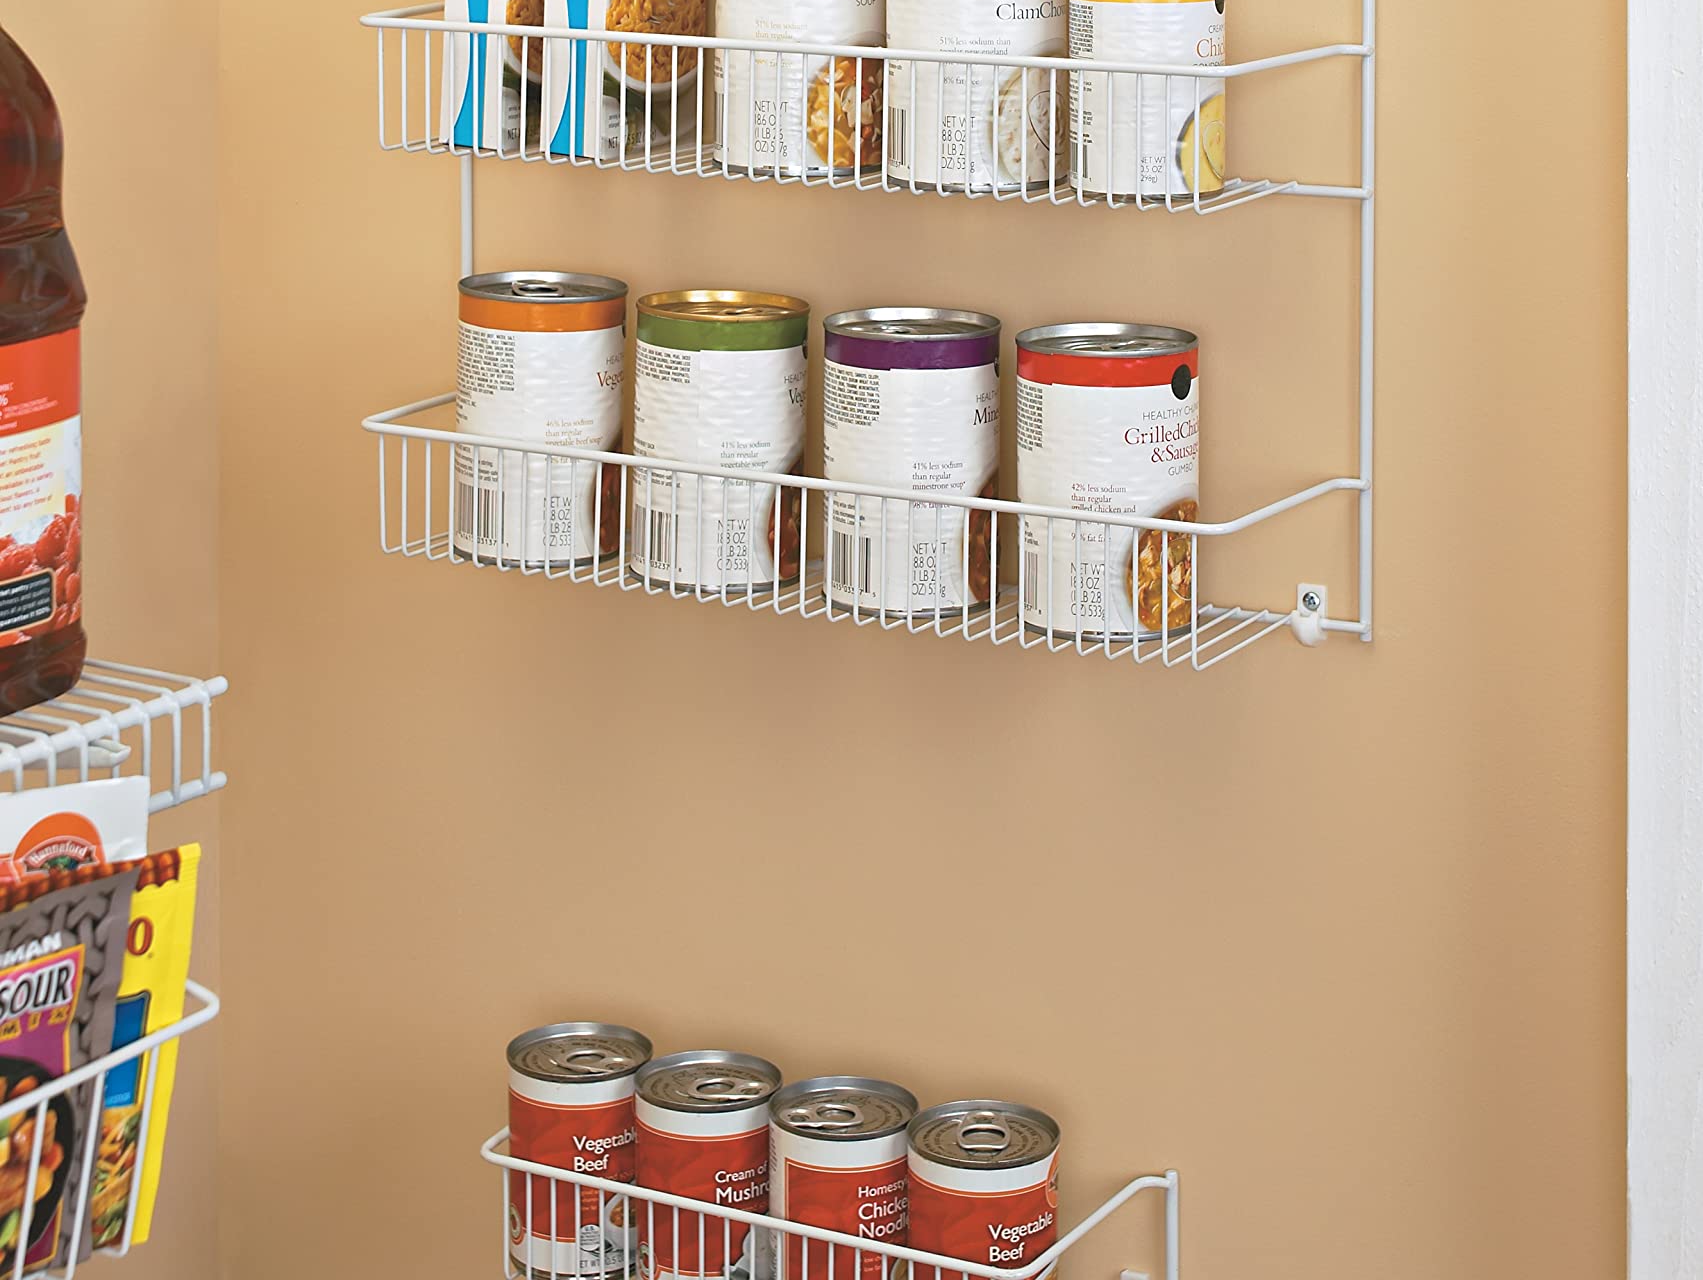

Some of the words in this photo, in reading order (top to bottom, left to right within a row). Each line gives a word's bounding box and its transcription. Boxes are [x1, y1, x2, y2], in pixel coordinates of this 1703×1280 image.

[754, 101, 771, 112] NET
[762, 128, 771, 139] LB
[947, 144, 957, 155] LB
[1142, 406, 1183, 421] HEALTHY
[913, 462, 928, 471] 41%
[941, 461, 963, 470] sodium
[1168, 462, 1194, 476] GUMBO
[912, 472, 927, 480] than
[929, 472, 952, 482] regular
[912, 482, 949, 490] minestrone
[1071, 483, 1086, 492] 42%
[1087, 484, 1099, 492] less
[1100, 484, 1127, 493] sodium
[1071, 493, 1086, 502] than
[1087, 494, 1112, 504] regular
[1094, 504, 1121, 513] chicken
[1123, 504, 1136, 513] and
[732, 532, 746, 544] OZ
[1087, 533, 1096, 542] fat
[919, 570, 929, 581] LB
[1086, 576, 1100, 590] OZ
[0, 966, 70, 1020] SOUR
[574, 1154, 609, 1171] Beef
[715, 1169, 755, 1183] Cream
[757, 1162, 768, 1176] of
[858, 1196, 909, 1220] Chicke
[859, 1210, 909, 1238] Noodl
[989, 1211, 1053, 1243] Vegetable
[989, 1242, 1025, 1262] Beef
